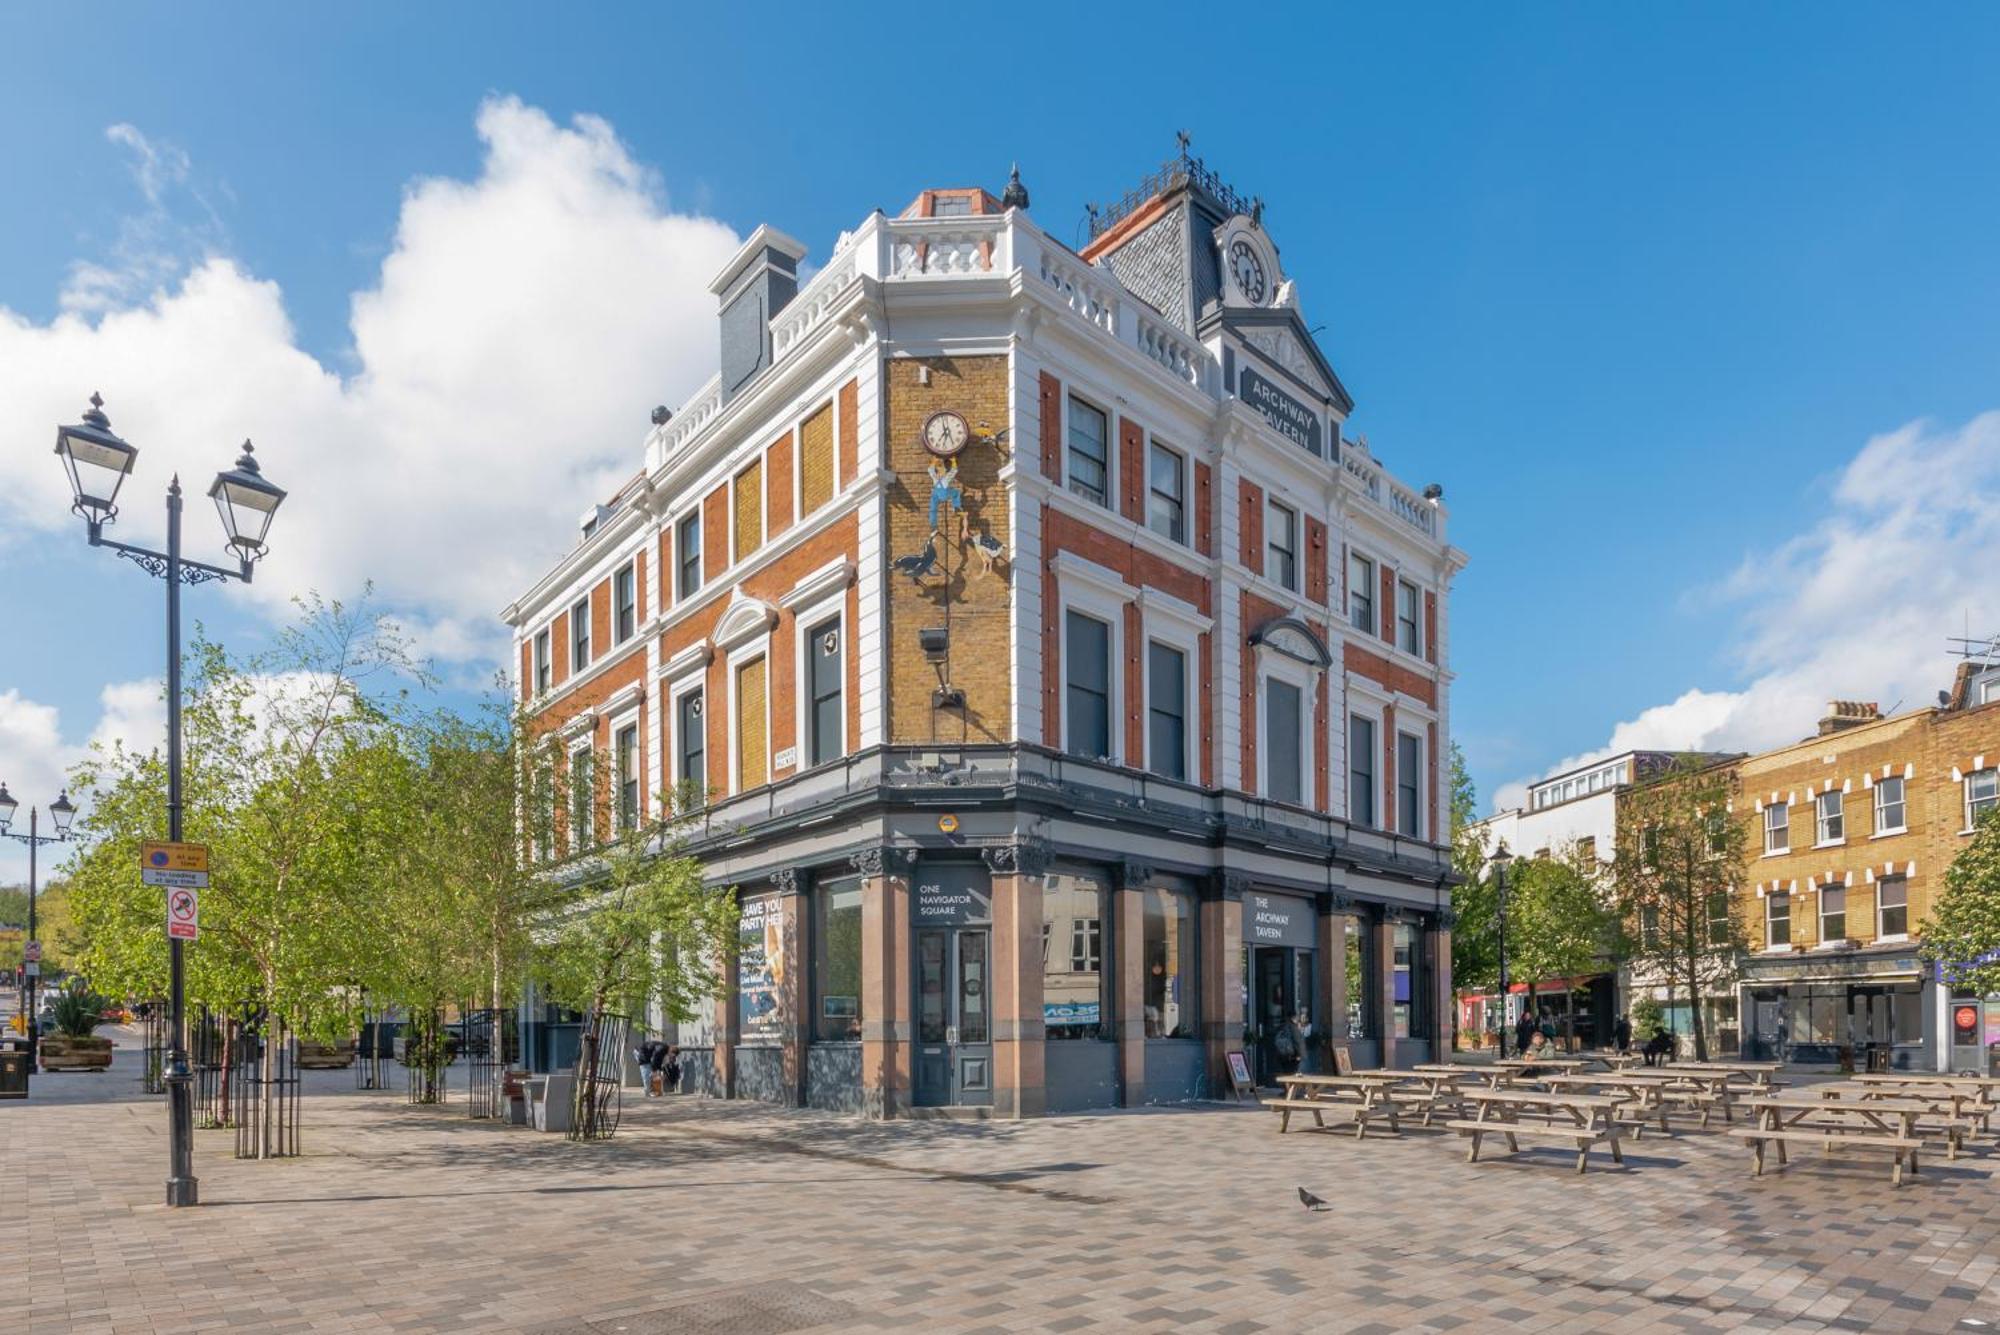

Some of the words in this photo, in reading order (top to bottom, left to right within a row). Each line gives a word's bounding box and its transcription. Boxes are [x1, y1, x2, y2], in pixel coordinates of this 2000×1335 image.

[1253, 380, 1312, 430] ARCHWAY
[168, 871, 196, 880] loading
[920, 885, 940, 894] ONE
[920, 896, 971, 904] NAVIGATOR
[1255, 897, 1268, 908] THE
[743, 901, 764, 917] HAVE
[920, 906, 956, 916] SQUARE
[740, 915, 765, 931] PARTY
[1256, 912, 1289, 925] ARCHWAY
[1256, 926, 1281, 938] TAVERN
